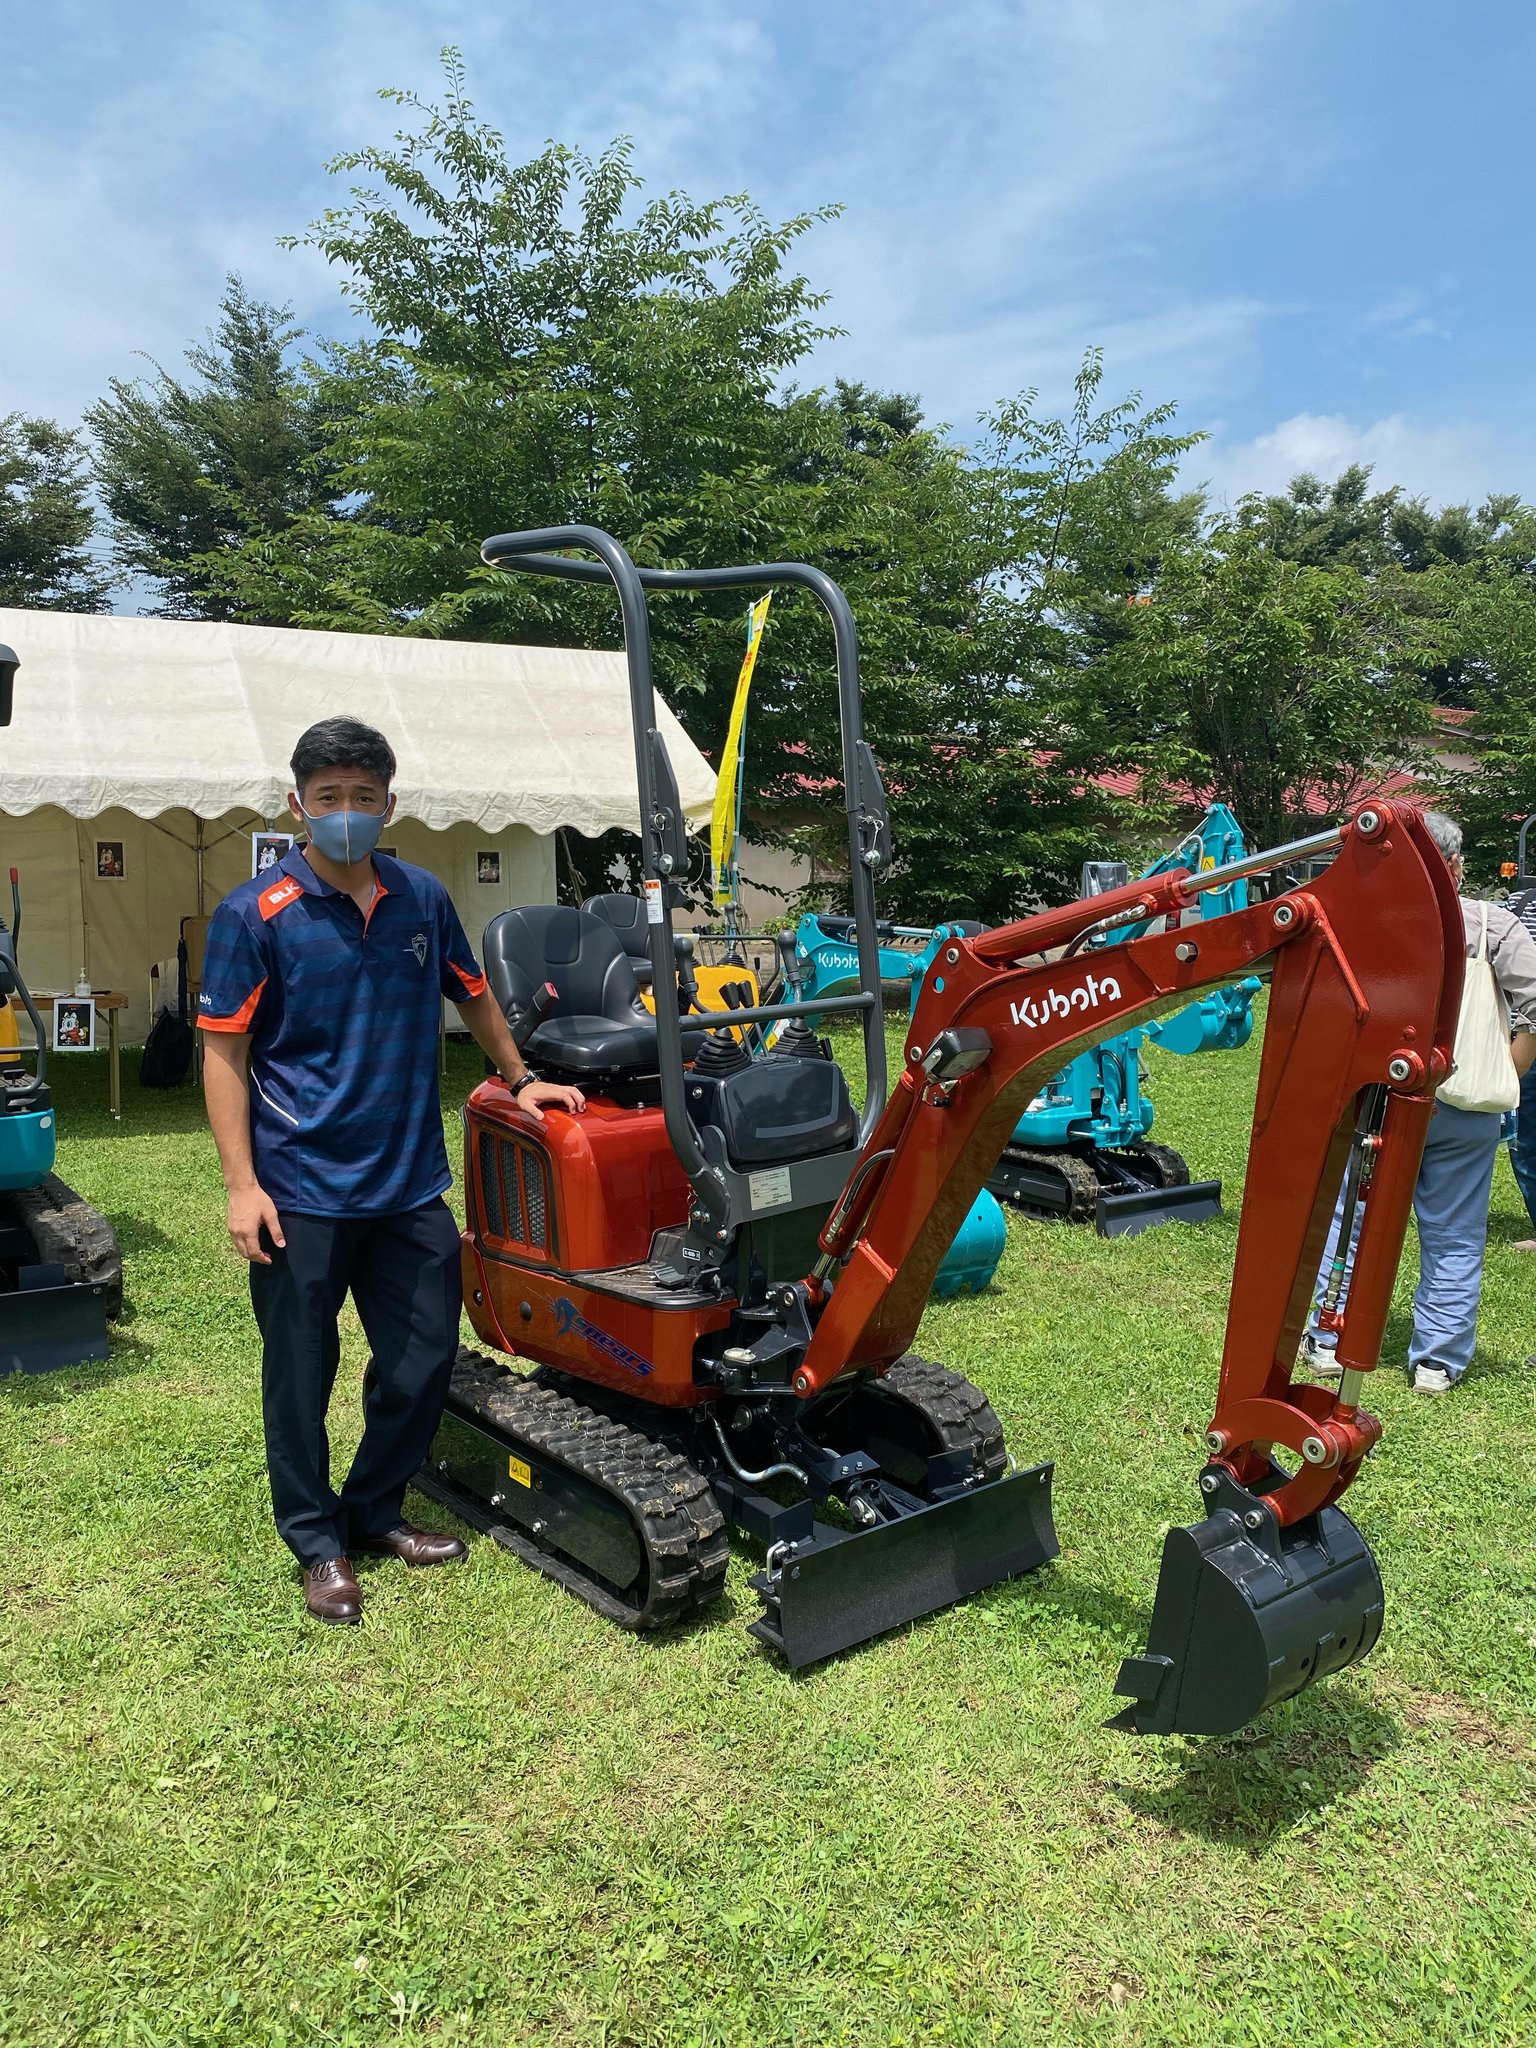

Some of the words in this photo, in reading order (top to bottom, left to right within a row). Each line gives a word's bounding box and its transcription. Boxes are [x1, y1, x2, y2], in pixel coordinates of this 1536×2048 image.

[268, 882, 300, 904] BLK
[818, 952, 860, 969] Kubota
[1010, 974, 1122, 1028] Kubota
